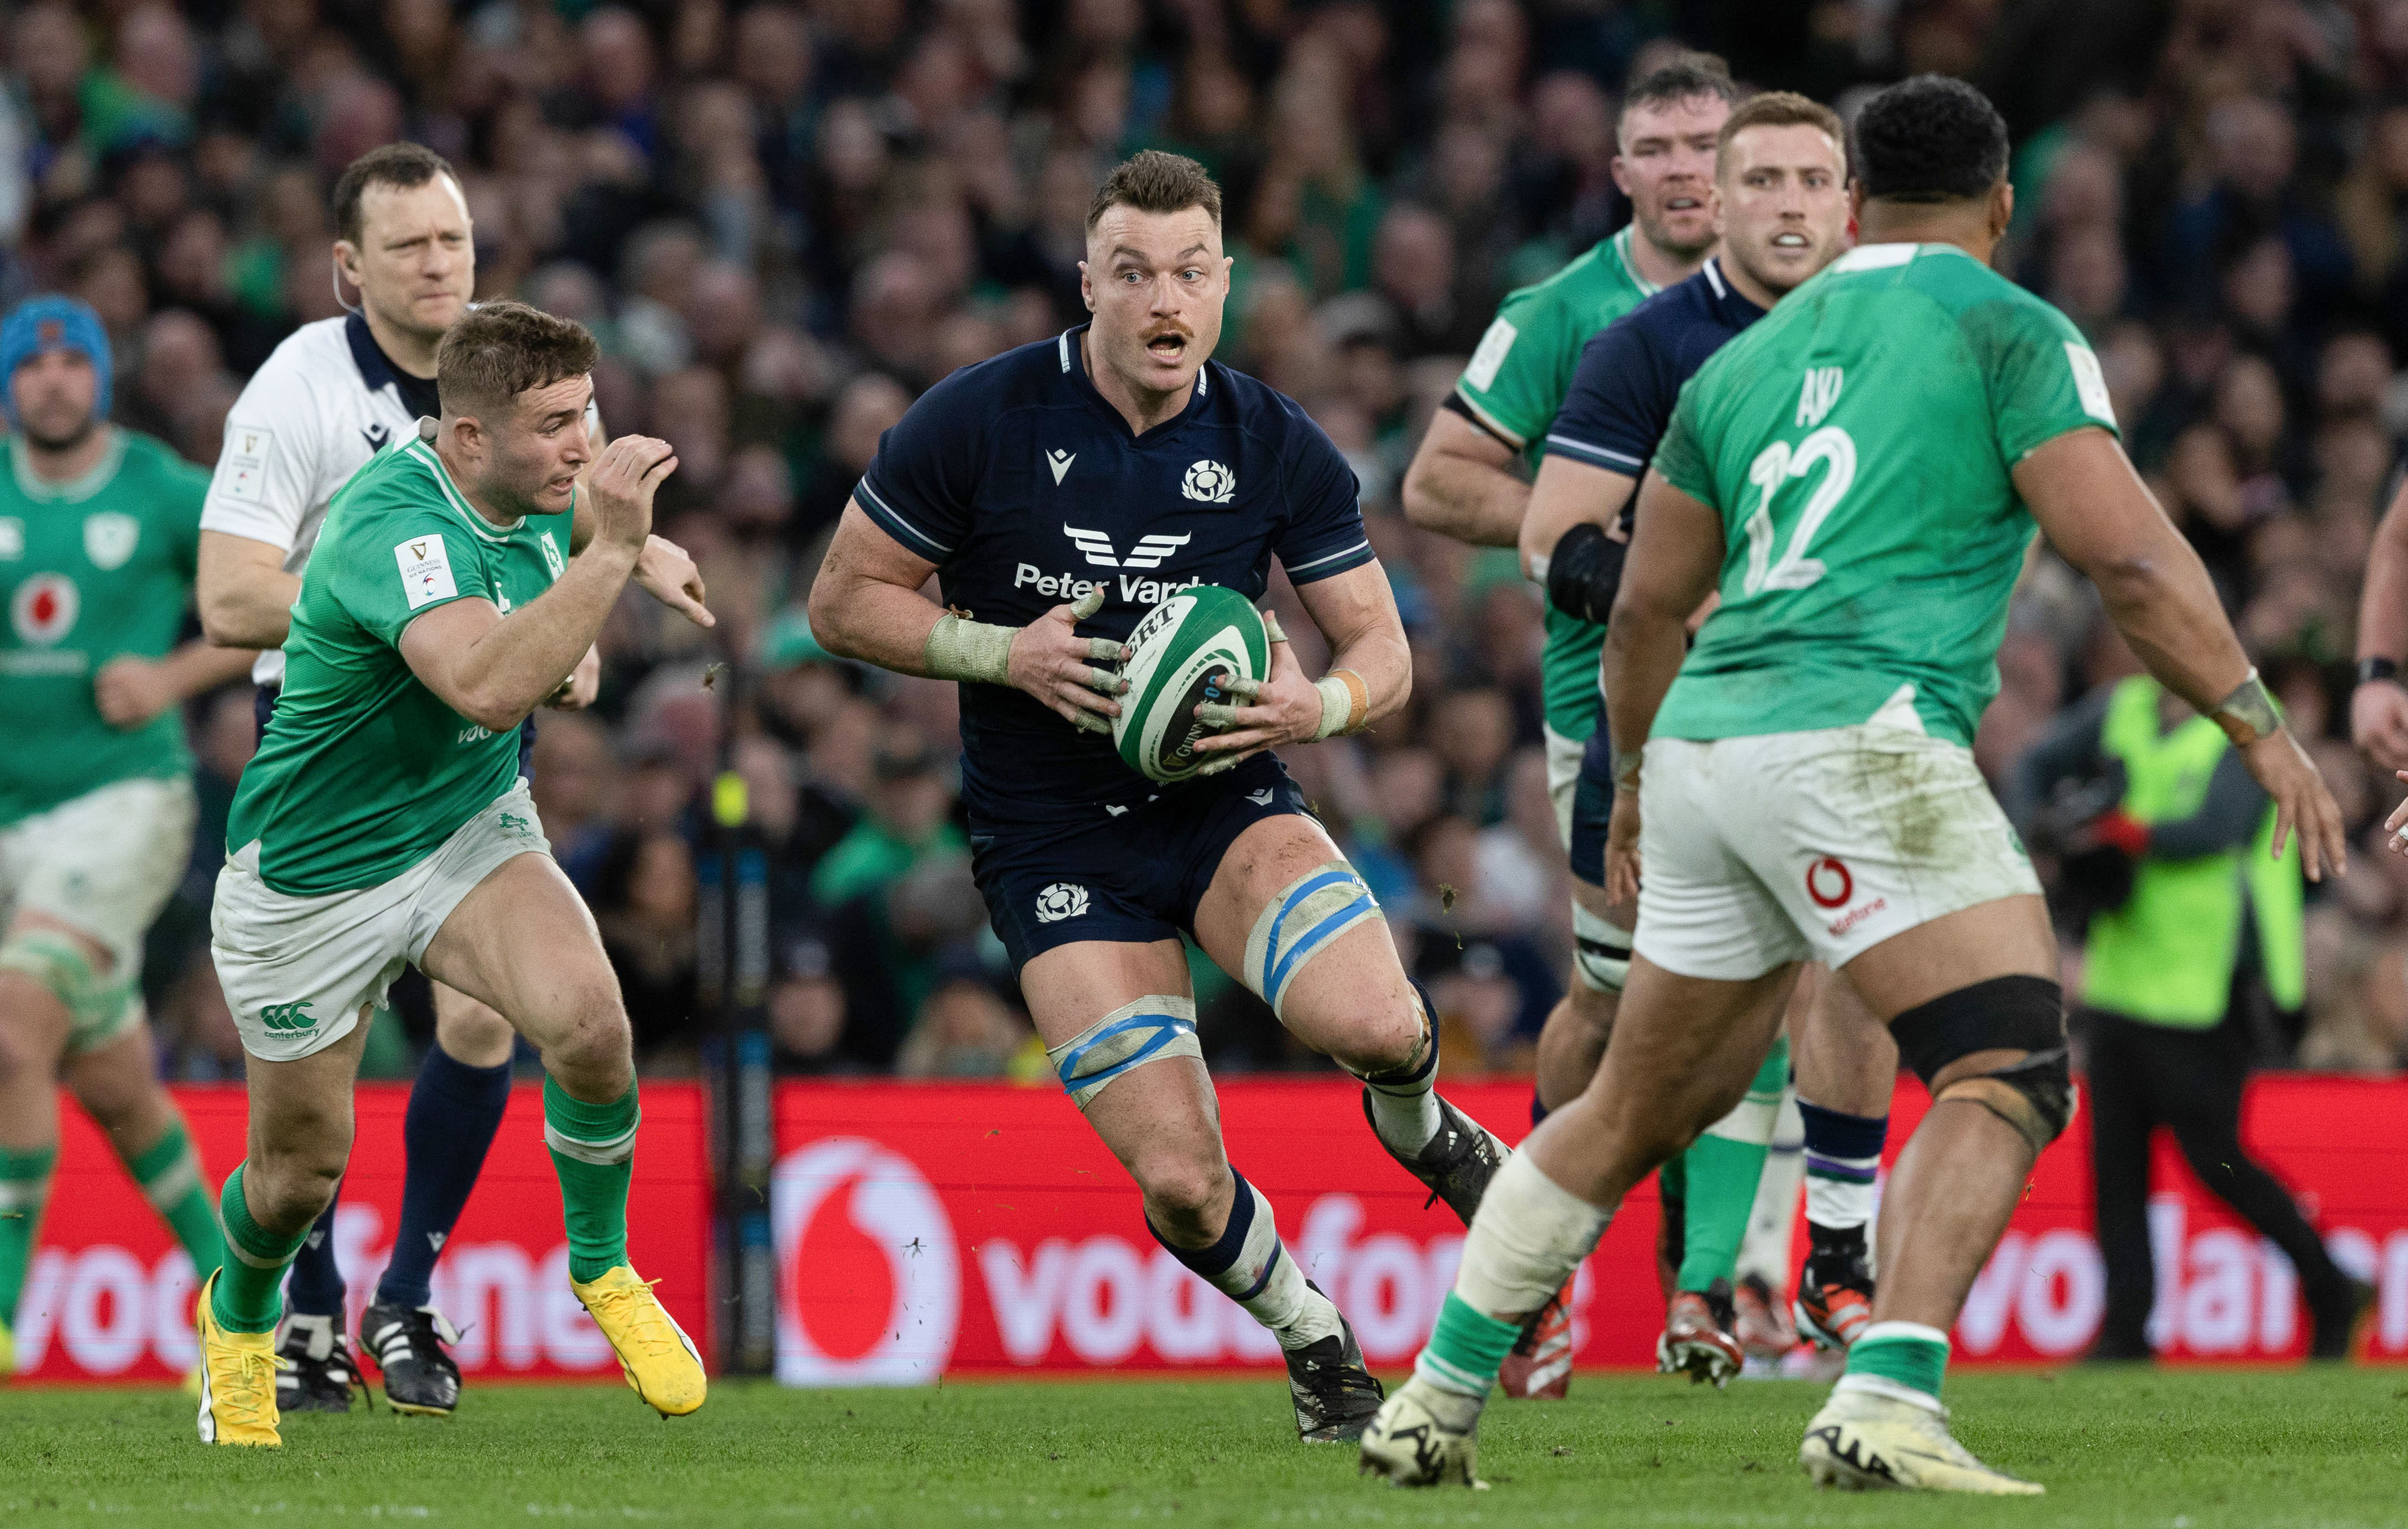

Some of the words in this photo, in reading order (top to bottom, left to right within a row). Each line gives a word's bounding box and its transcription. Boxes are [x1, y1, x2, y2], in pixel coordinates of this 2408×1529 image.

[1744, 425, 1857, 597] 12
[407, 559, 441, 573] GUINNESS
[418, 565, 442, 575] NATIONS
[264, 1028, 320, 1039] canterbury
